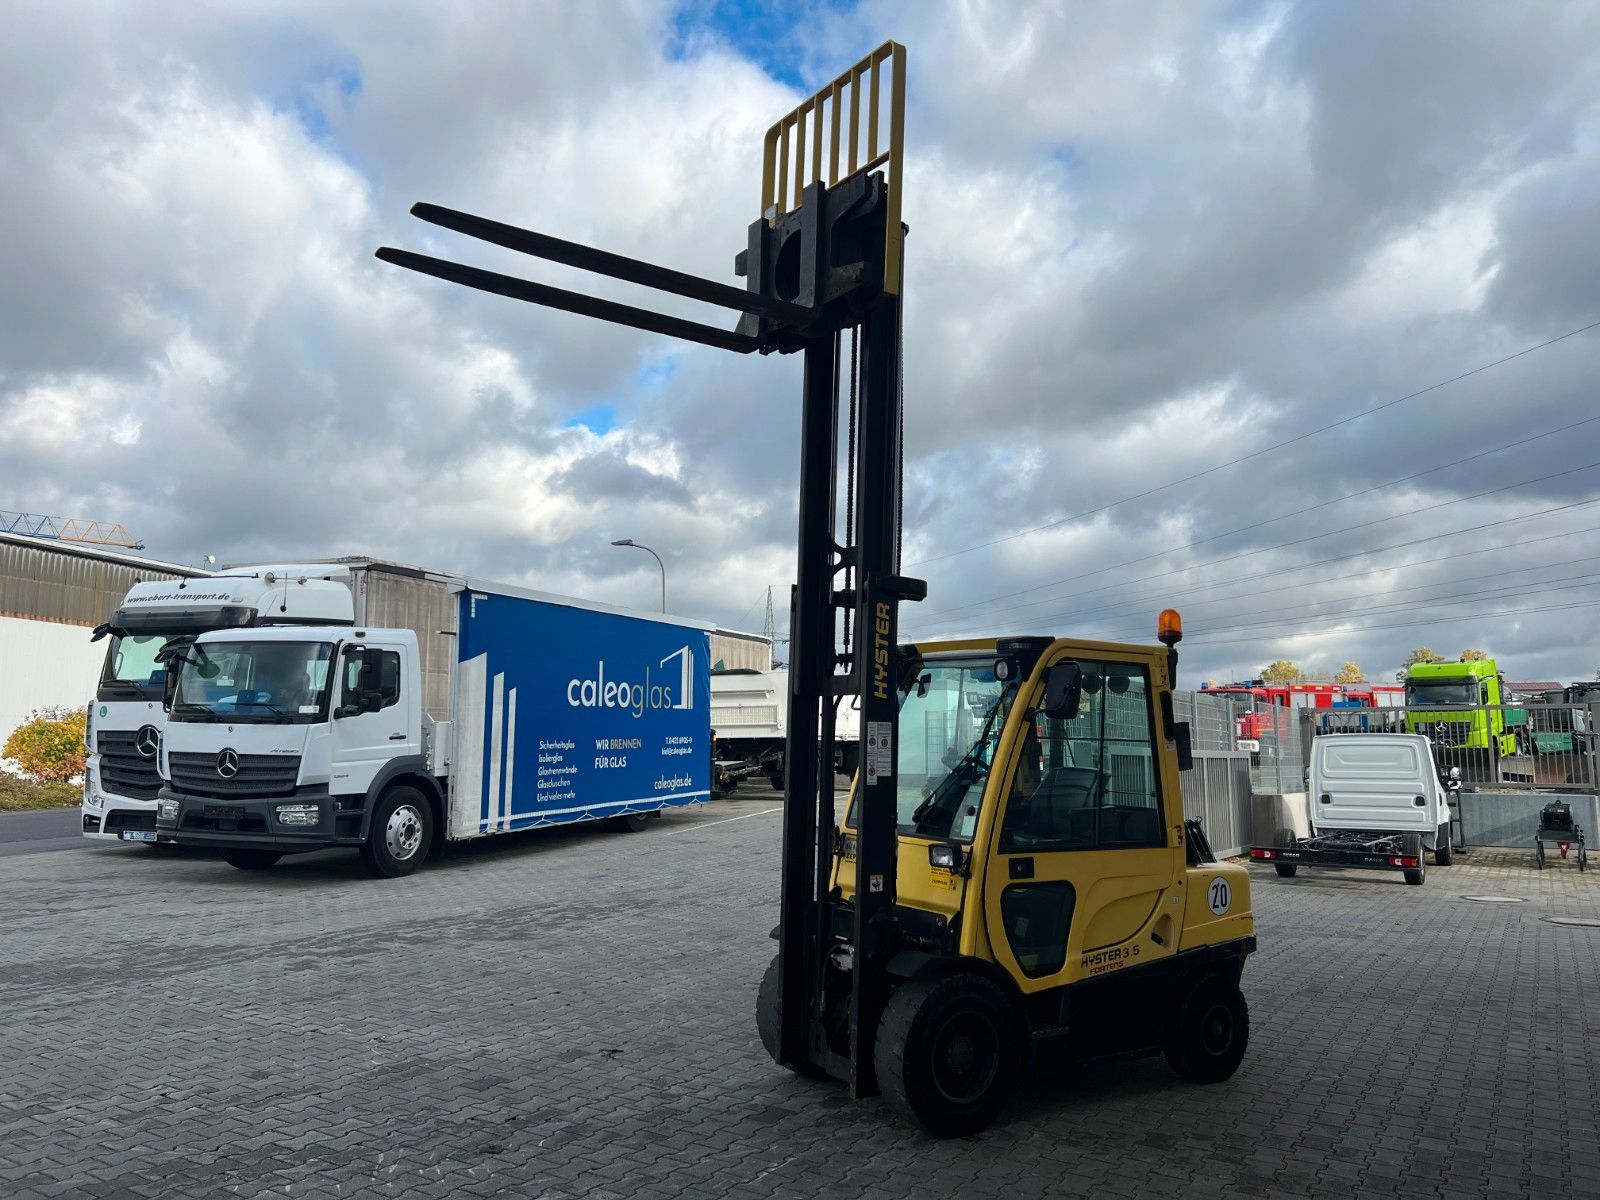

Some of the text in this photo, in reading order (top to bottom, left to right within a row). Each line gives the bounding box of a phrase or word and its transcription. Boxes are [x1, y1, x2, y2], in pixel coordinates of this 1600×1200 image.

[127, 593, 230, 603] www.ebert-transport.de
[874, 602, 890, 699] HYSTER
[567, 660, 671, 718] caleoglas
[539, 740, 575, 750] Sicherheitsglas
[596, 738, 642, 750] WIR BRENNEN
[539, 753, 563, 764] Isolierglas
[594, 755, 627, 769] FÜR GLAS
[537, 777, 570, 788] Glasduschen
[654, 773, 692, 791] caleoglas.de
[537, 790, 576, 802] Und vieles mehr
[1212, 884, 1228, 909] 20
[1081, 945, 1140, 968] HYSTER 3.5
[1089, 960, 1124, 975] FORTENS
